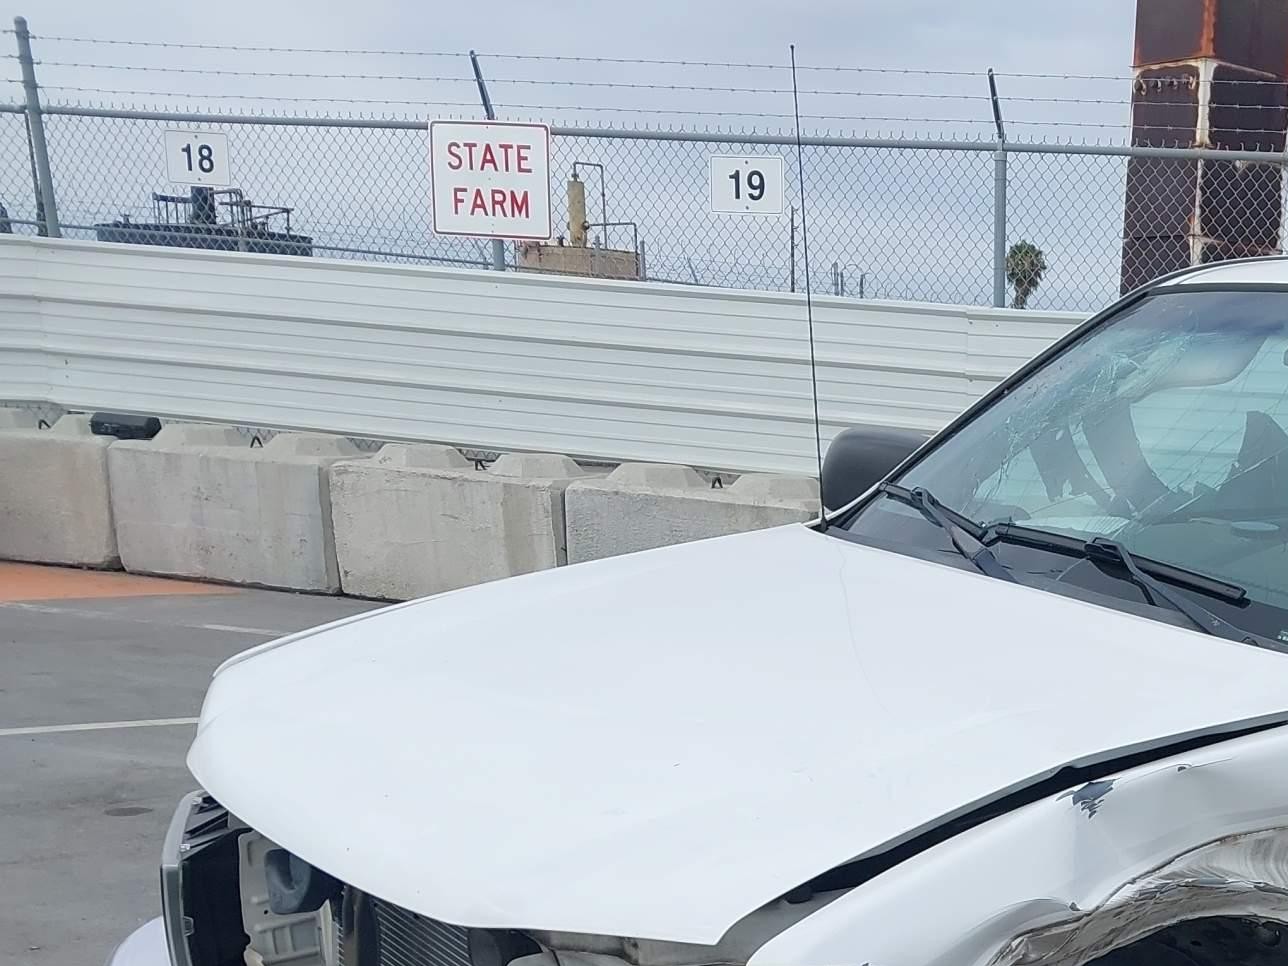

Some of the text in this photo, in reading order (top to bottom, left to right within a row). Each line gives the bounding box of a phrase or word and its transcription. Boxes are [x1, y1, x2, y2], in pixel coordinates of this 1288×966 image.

[181, 143, 214, 173] 18
[447, 141, 533, 173] STATE
[728, 169, 766, 203] 19
[453, 187, 530, 219] FARM
